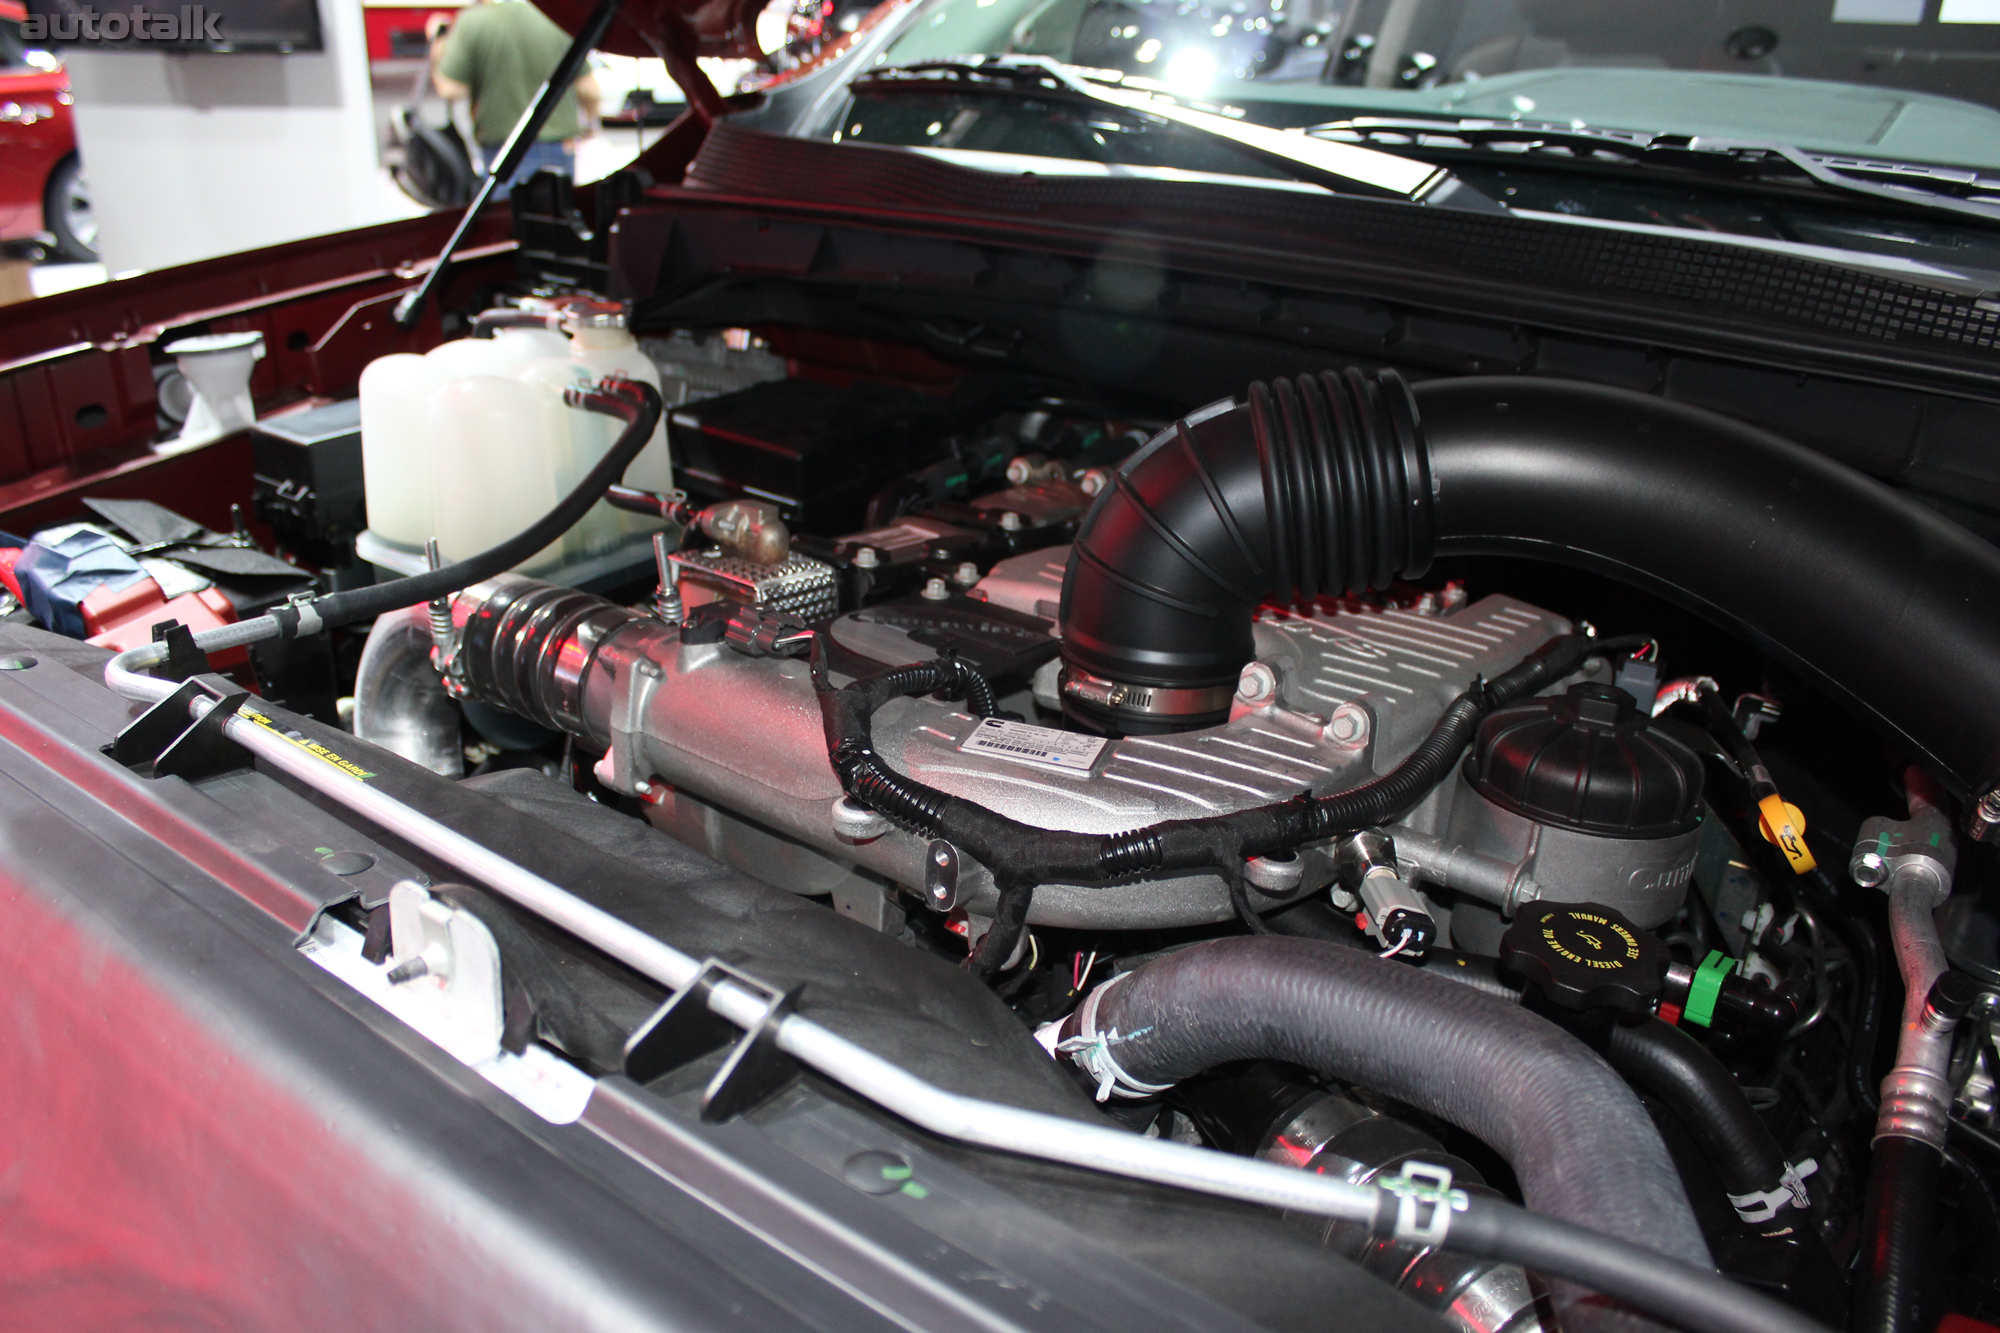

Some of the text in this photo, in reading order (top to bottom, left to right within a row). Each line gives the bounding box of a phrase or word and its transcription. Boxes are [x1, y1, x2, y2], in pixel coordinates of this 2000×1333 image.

[307, 743, 331, 755] MISE
[325, 752, 342, 762] EN
[1568, 912, 1608, 926] MANUAL
[1542, 929, 1623, 969] DIESEL ENGINE OIL
[1626, 947, 1639, 960] SEE
